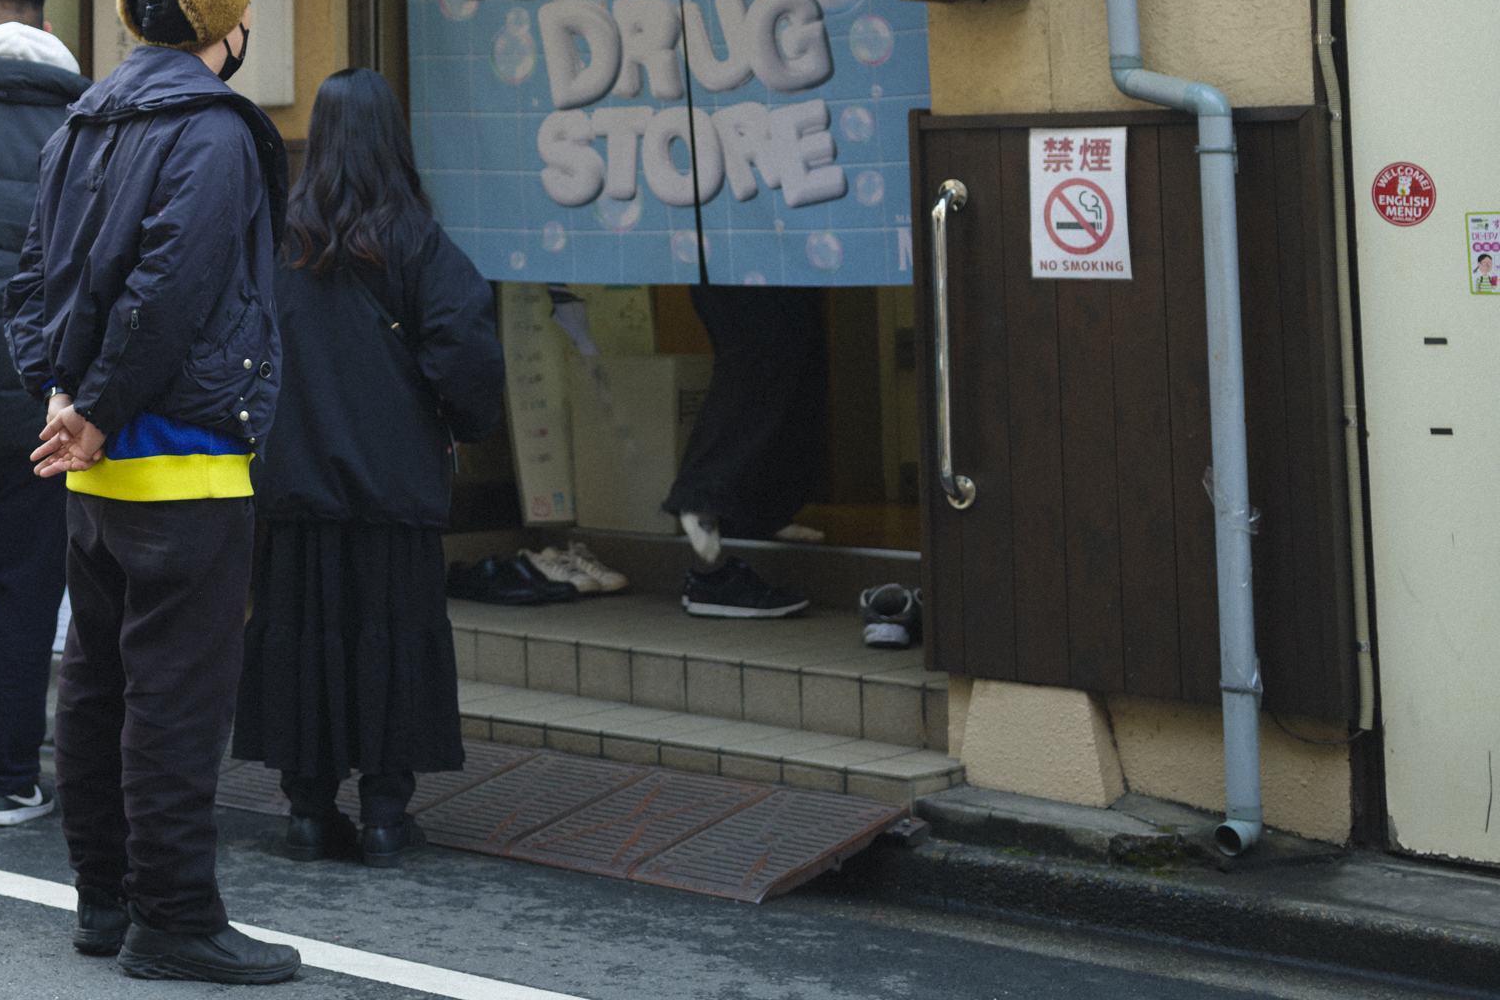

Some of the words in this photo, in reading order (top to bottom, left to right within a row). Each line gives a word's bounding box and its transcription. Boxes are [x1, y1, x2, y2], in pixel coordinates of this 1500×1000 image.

[537, 100, 848, 208] STORE
[1043, 137, 1112, 173] 禁煙
[1377, 166, 1431, 191] WELCOME!
[1378, 194, 1430, 208] ENGLISH
[1385, 206, 1422, 218] MENU
[1040, 260, 1058, 271] NO
[1062, 260, 1124, 272] SMOKING
